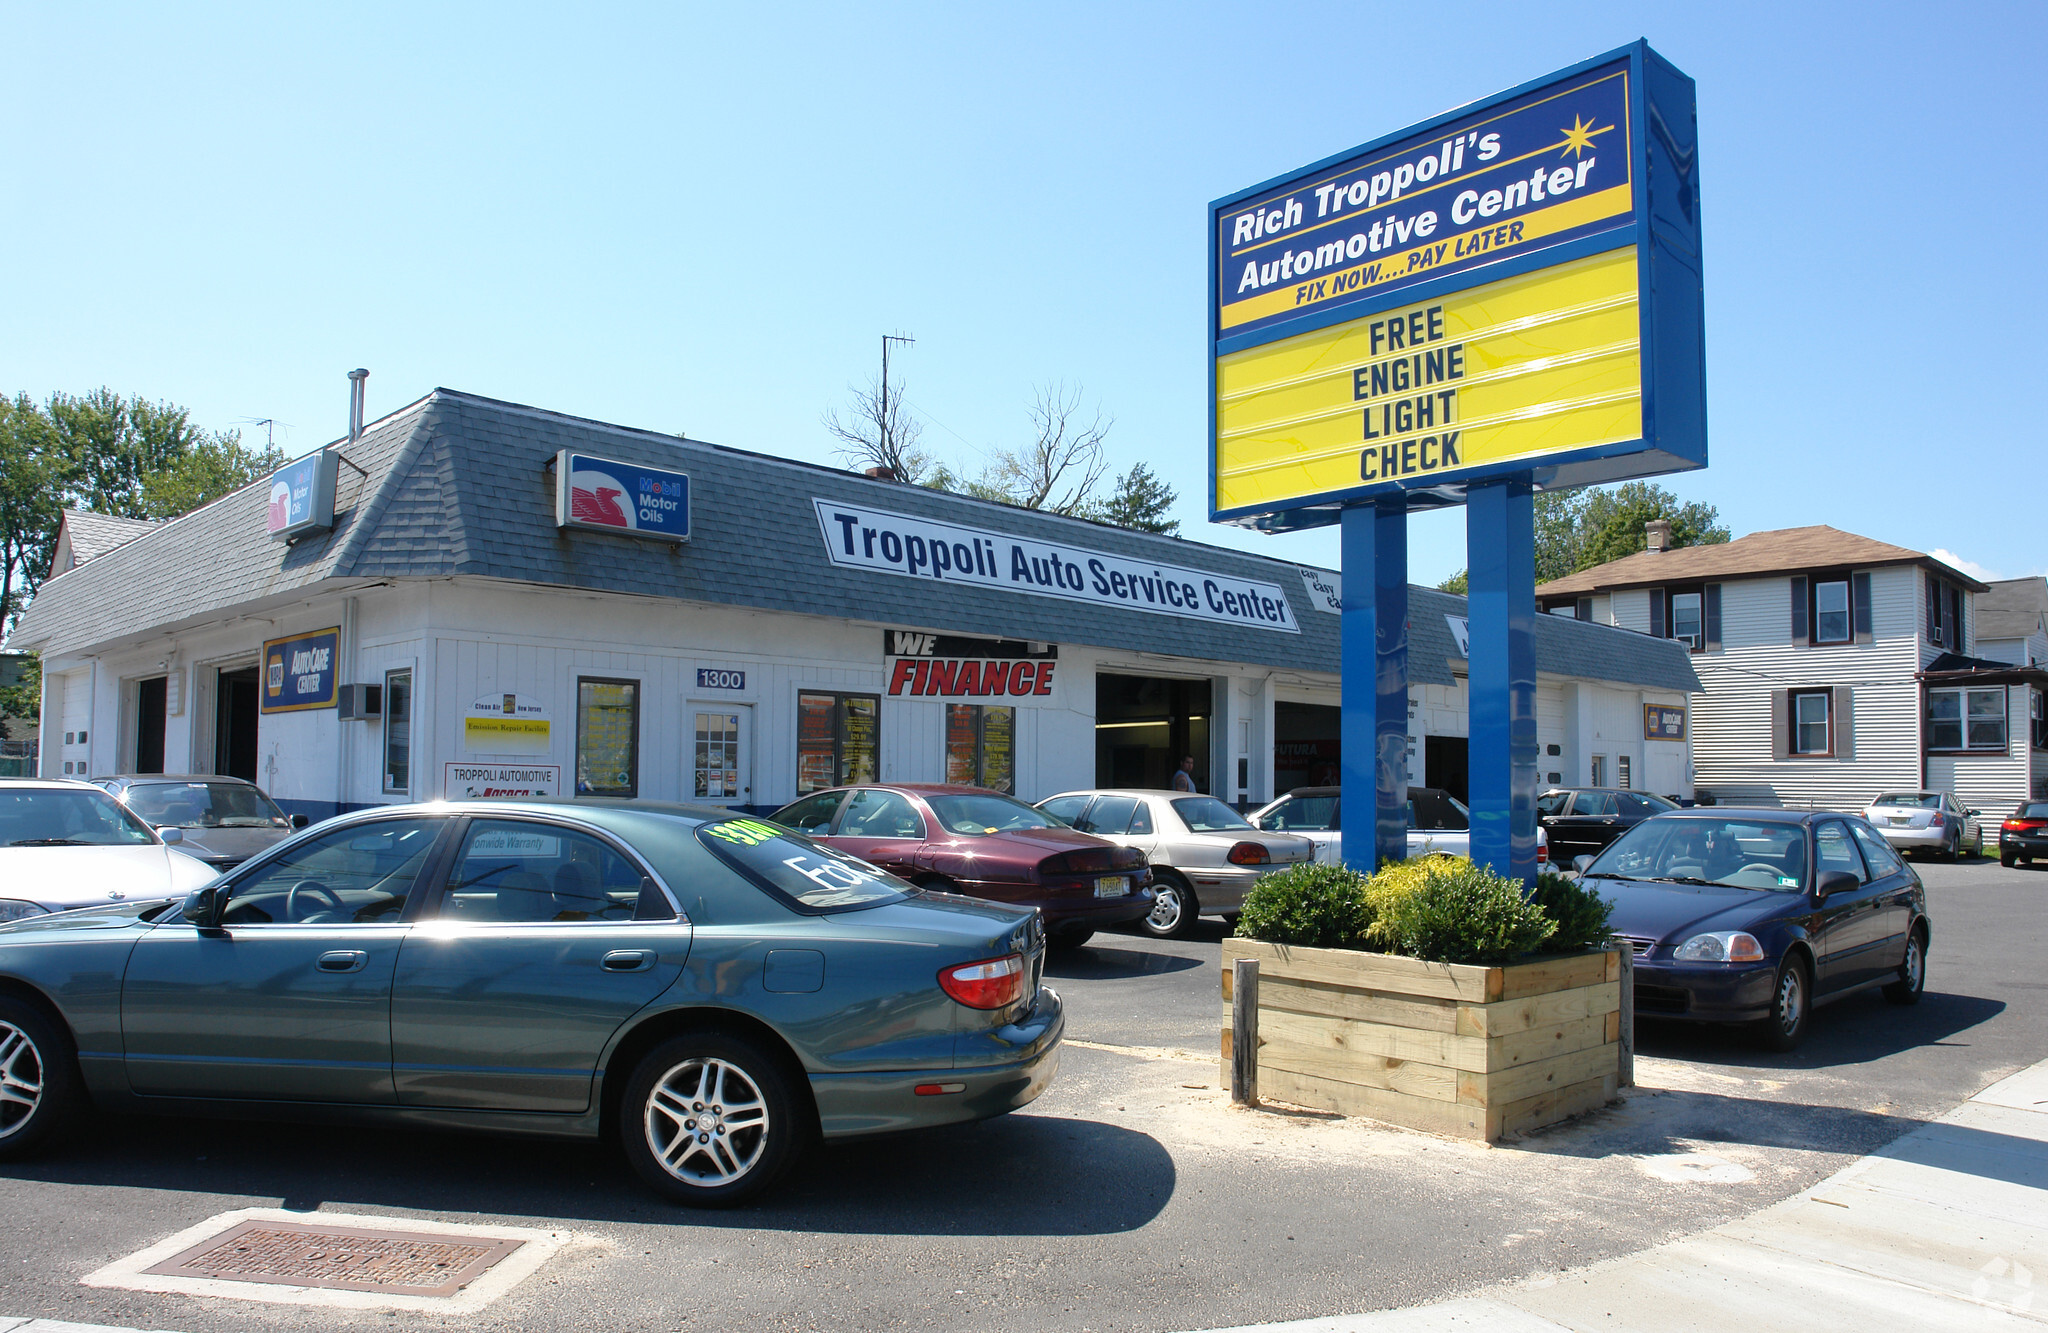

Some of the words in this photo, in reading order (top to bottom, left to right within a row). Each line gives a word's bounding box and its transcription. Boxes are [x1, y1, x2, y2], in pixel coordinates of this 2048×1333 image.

[1232, 196, 1302, 247] Rich
[1314, 131, 1502, 219] Troppoli's
[1237, 210, 1439, 295] Automotive
[1450, 155, 1597, 227] Center
[1295, 276, 1326, 306] FIX
[1453, 219, 1526, 258] LATER
[1369, 304, 1444, 357] FREE
[1353, 343, 1464, 402] ENGINE
[1363, 388, 1456, 441] LIGHT
[1360, 430, 1461, 481] CHECK
[293, 486, 309, 501] Motor
[640, 477, 681, 498] Mobil
[291, 502, 302, 516] Oils
[640, 493, 679, 512] Motor
[640, 508, 664, 523] Oils
[833, 512, 999, 580] Troppoli
[1010, 545, 1085, 592] Auto
[1087, 557, 1200, 610] Service
[1203, 578, 1287, 624] Center
[1300, 568, 1319, 583] easy
[1312, 581, 1335, 596] easy
[893, 631, 938, 656] WE
[297, 673, 321, 694] CENTER
[702, 670, 741, 688] 1300
[887, 658, 1056, 697] FINANCE
[492, 703, 501, 711] Air
[527, 705, 542, 713] Jersey
[468, 723, 499, 731] Emission
[500, 724, 522, 733] Repair
[524, 725, 548, 733] Facility
[454, 768, 497, 781] TROPPOLI
[499, 770, 552, 782] AUTOMOTIVE
[506, 837, 545, 851] Warranty
[301, 1251, 383, 1266] DOT
